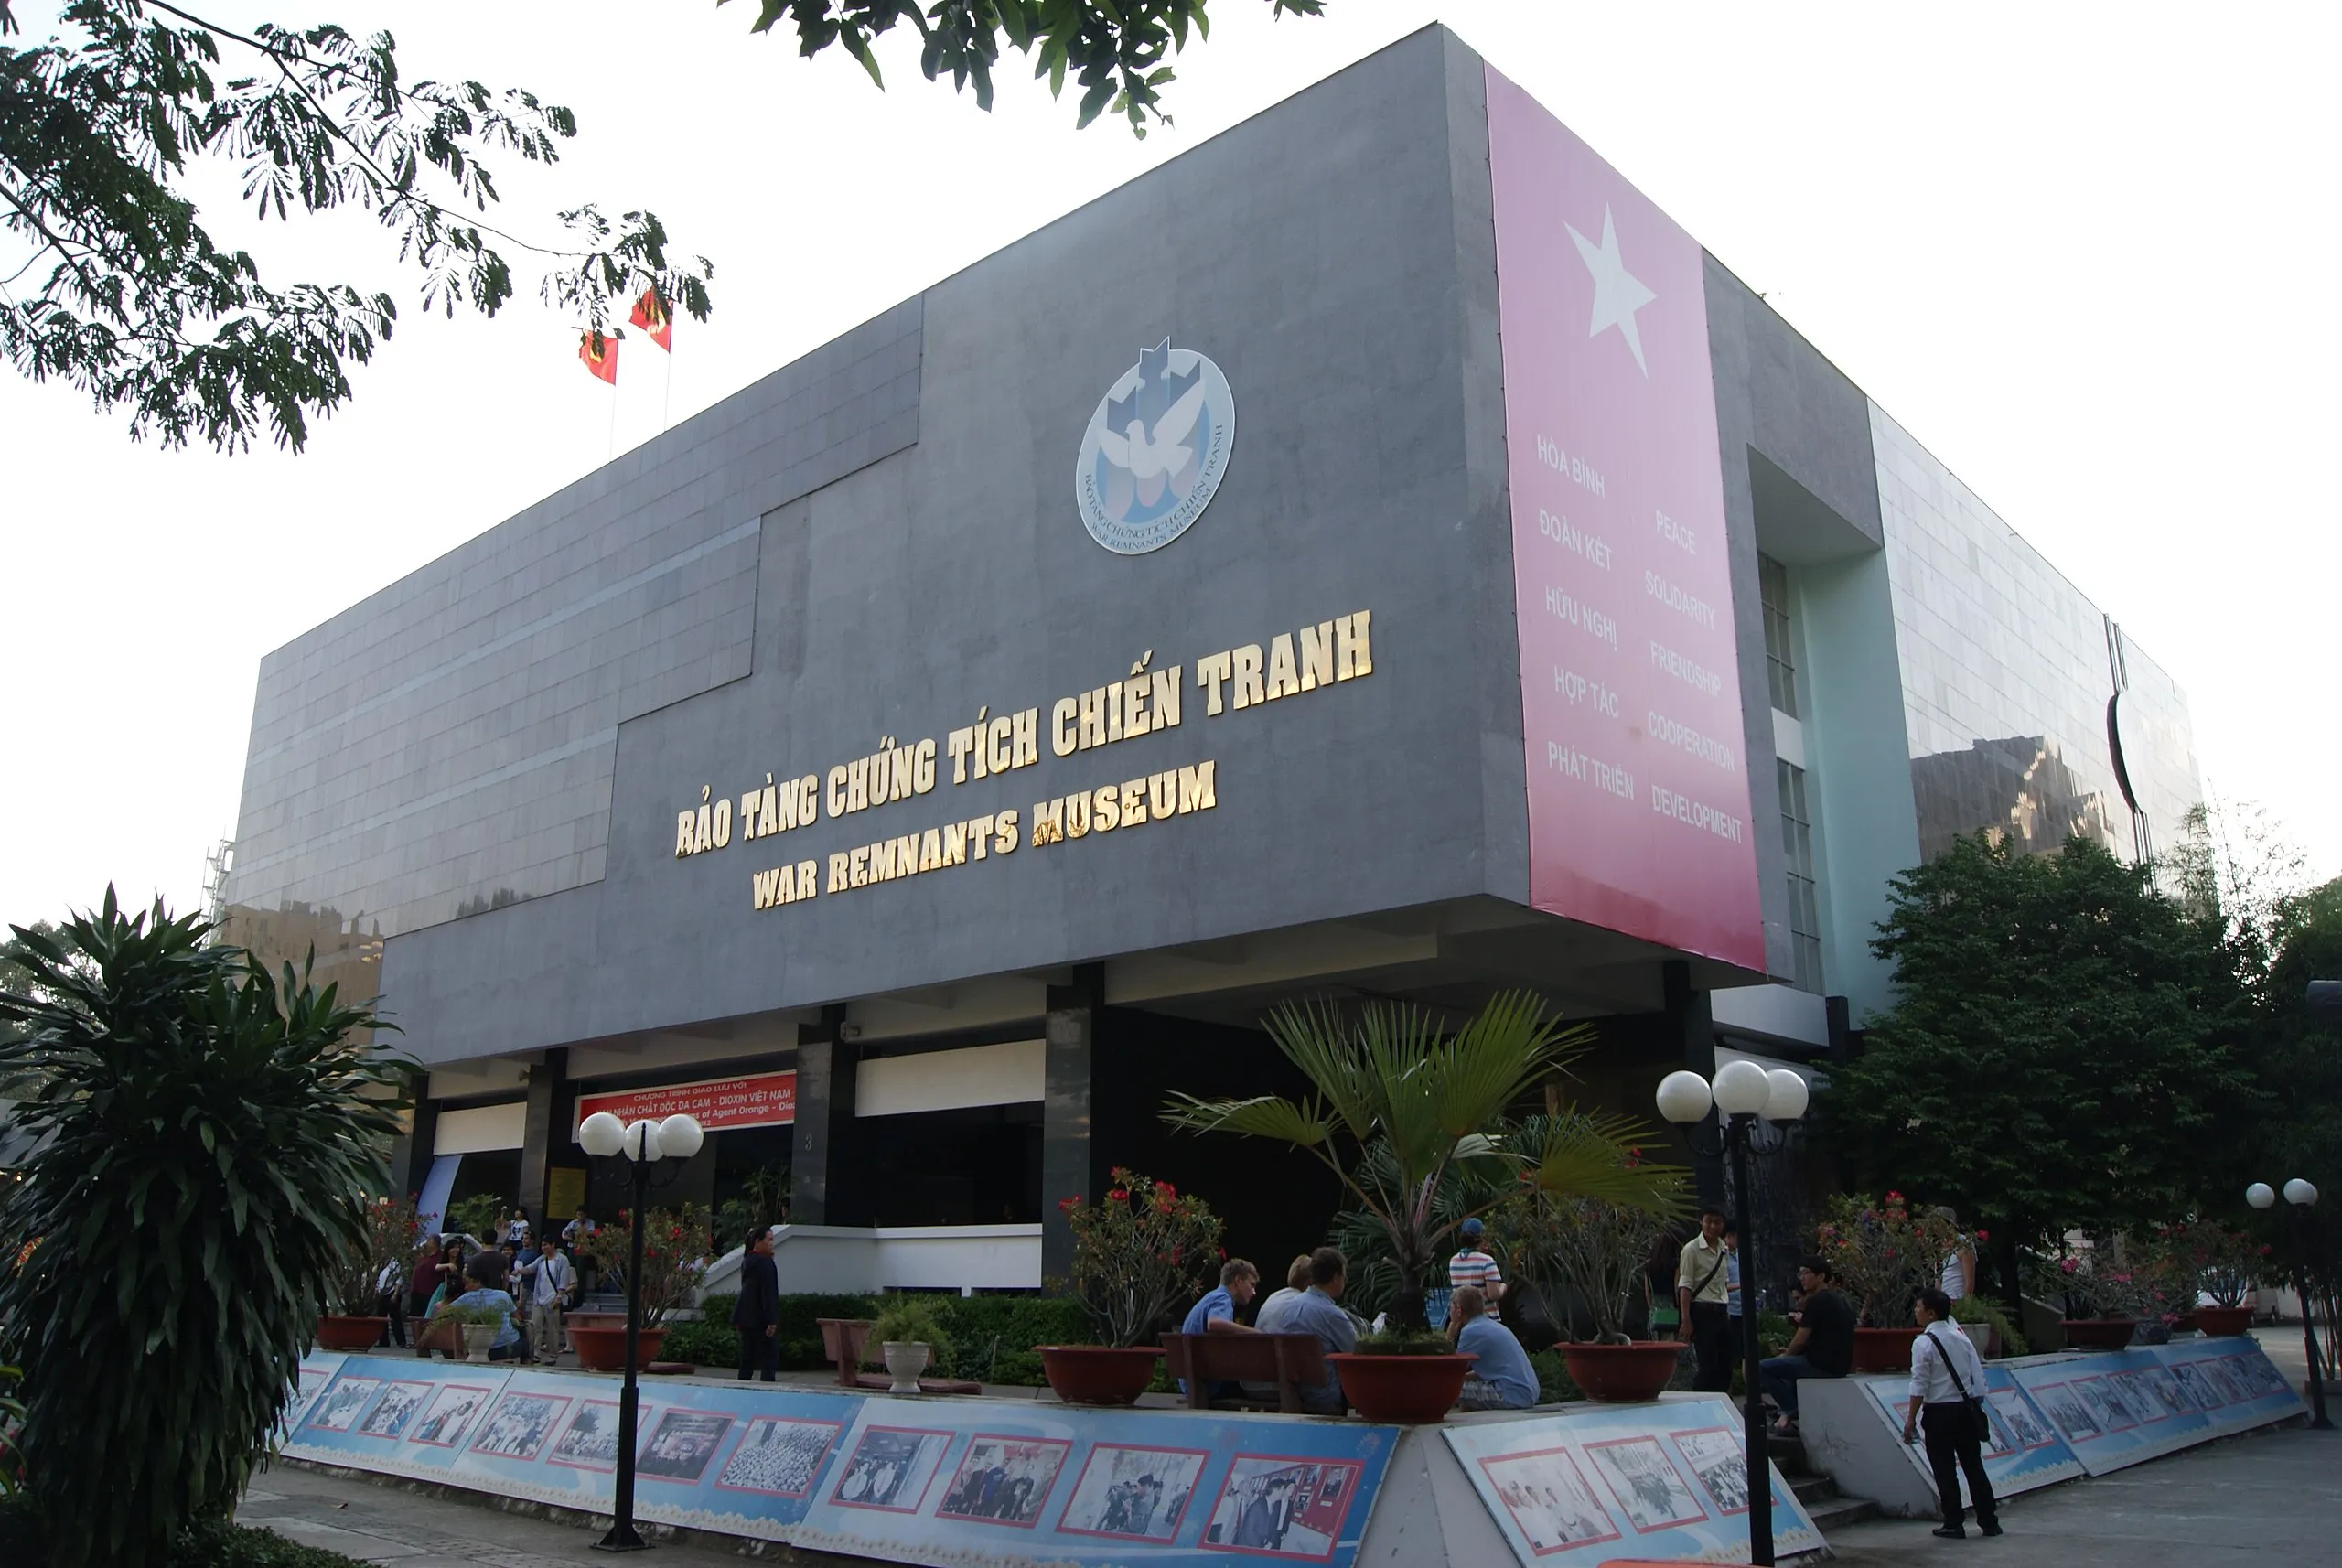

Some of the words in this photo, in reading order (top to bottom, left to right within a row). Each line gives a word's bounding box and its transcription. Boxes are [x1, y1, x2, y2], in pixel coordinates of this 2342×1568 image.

[1203, 424, 1223, 478] TRANH
[1537, 434, 1570, 478] HÒA
[1572, 456, 1606, 499] BÌNH
[1539, 508, 1583, 554] ĐOÀN
[1585, 534, 1613, 572] KẾT
[1656, 510, 1697, 555] PEACE
[1545, 585, 1579, 626] HỮU
[1582, 604, 1617, 651] NGHỊ
[1645, 569, 1715, 631] SOLIDARITY
[1554, 665, 1587, 705] HỢP
[1589, 681, 1619, 719] TÁC
[1650, 640, 1722, 698] FRIENDSHIP
[675, 785, 731, 857] BẢO
[741, 772, 820, 841] TÀNG
[825, 735, 937, 820] CHỨNG
[947, 705, 1039, 784] TÍCH
[1051, 650, 1182, 757] CHIẾN
[1197, 609, 1373, 716] TRANH
[1648, 709, 1735, 773] COOPERATION
[1547, 740, 1588, 783] PHÁT
[1592, 758, 1635, 801] TRIỂN
[753, 860, 820, 910] WAR
[827, 809, 1020, 894] REMNANTS
[1031, 759, 1218, 847] MUSEUM
[1651, 783, 1743, 844] DEVELOPMENT
[678, 1101, 690, 1111] DA
[692, 1098, 711, 1108] CAM
[719, 1093, 747, 1105] DIOXIN
[749, 1089, 768, 1103] VIỆT
[769, 1089, 791, 1100] NAM
[693, 1086, 712, 1095] GIAO
[702, 1110, 711, 1119] of
[712, 1108, 736, 1119] Agent
[738, 1104, 769, 1115] Orange
